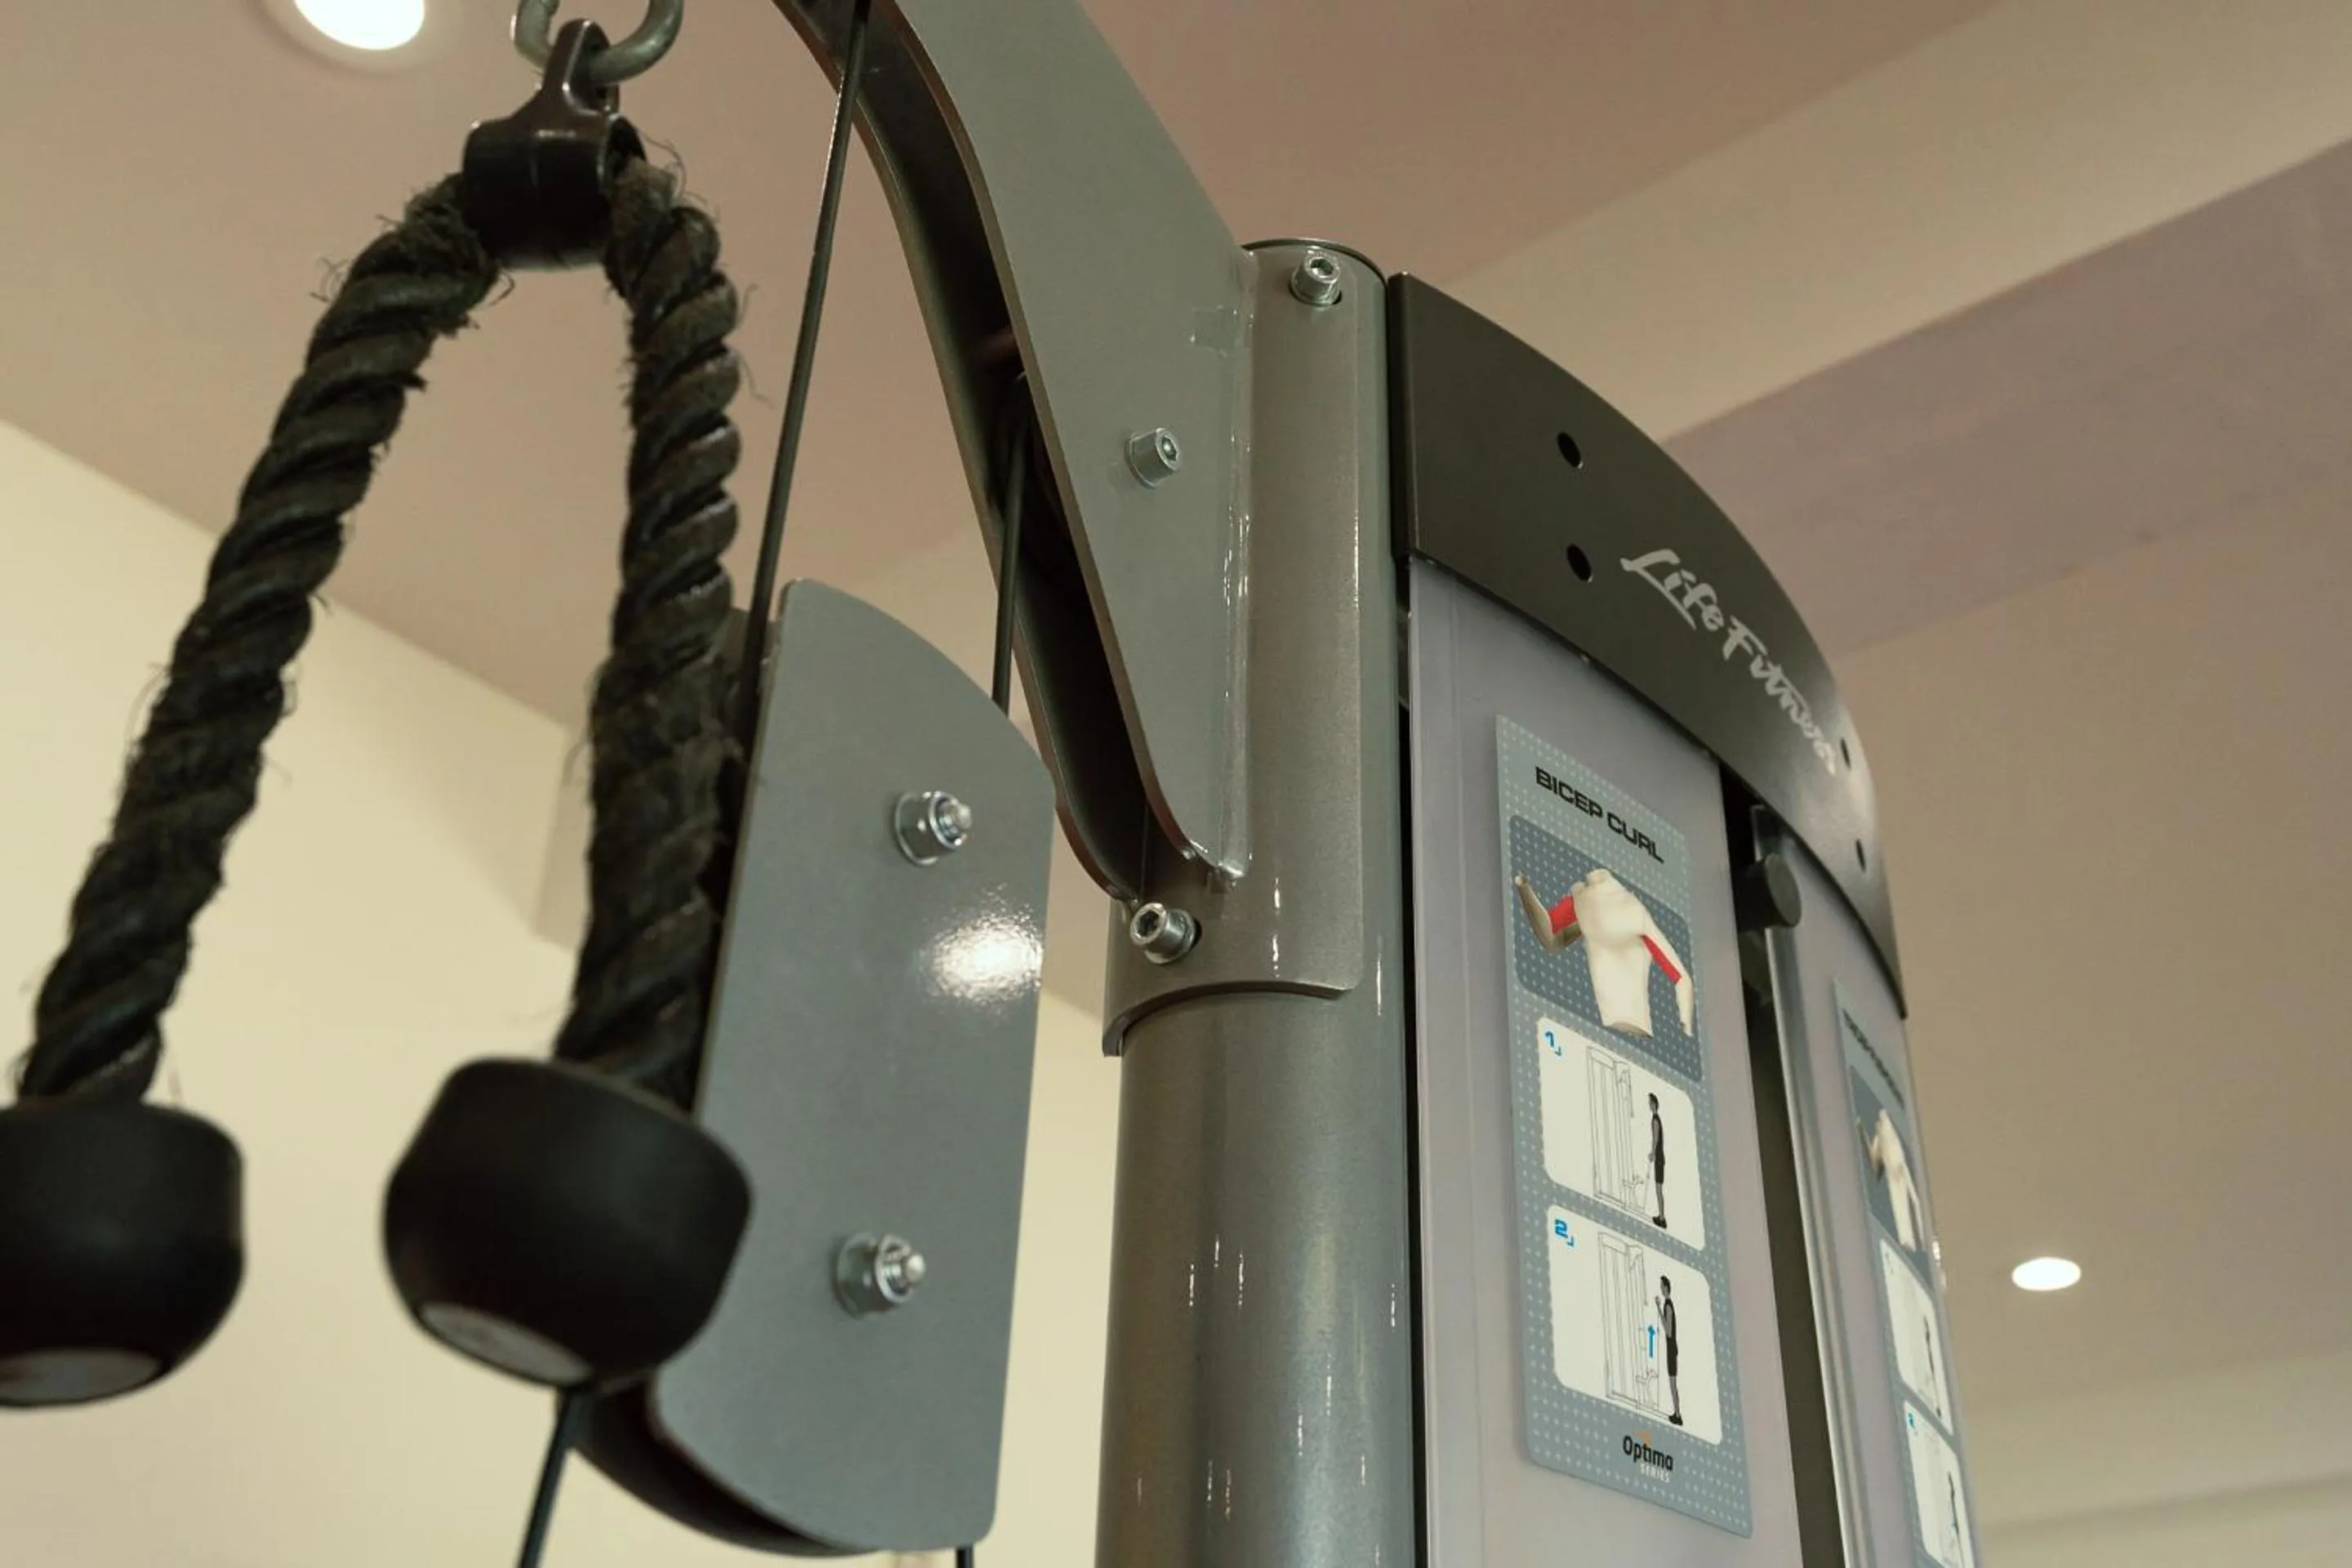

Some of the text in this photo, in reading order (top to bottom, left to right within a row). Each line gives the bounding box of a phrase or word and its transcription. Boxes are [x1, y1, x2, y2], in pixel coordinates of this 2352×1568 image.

[1619, 548, 1725, 631] Life
[1535, 764, 1665, 864] BICEP CURL
[1622, 1435, 1674, 1472] Optima
